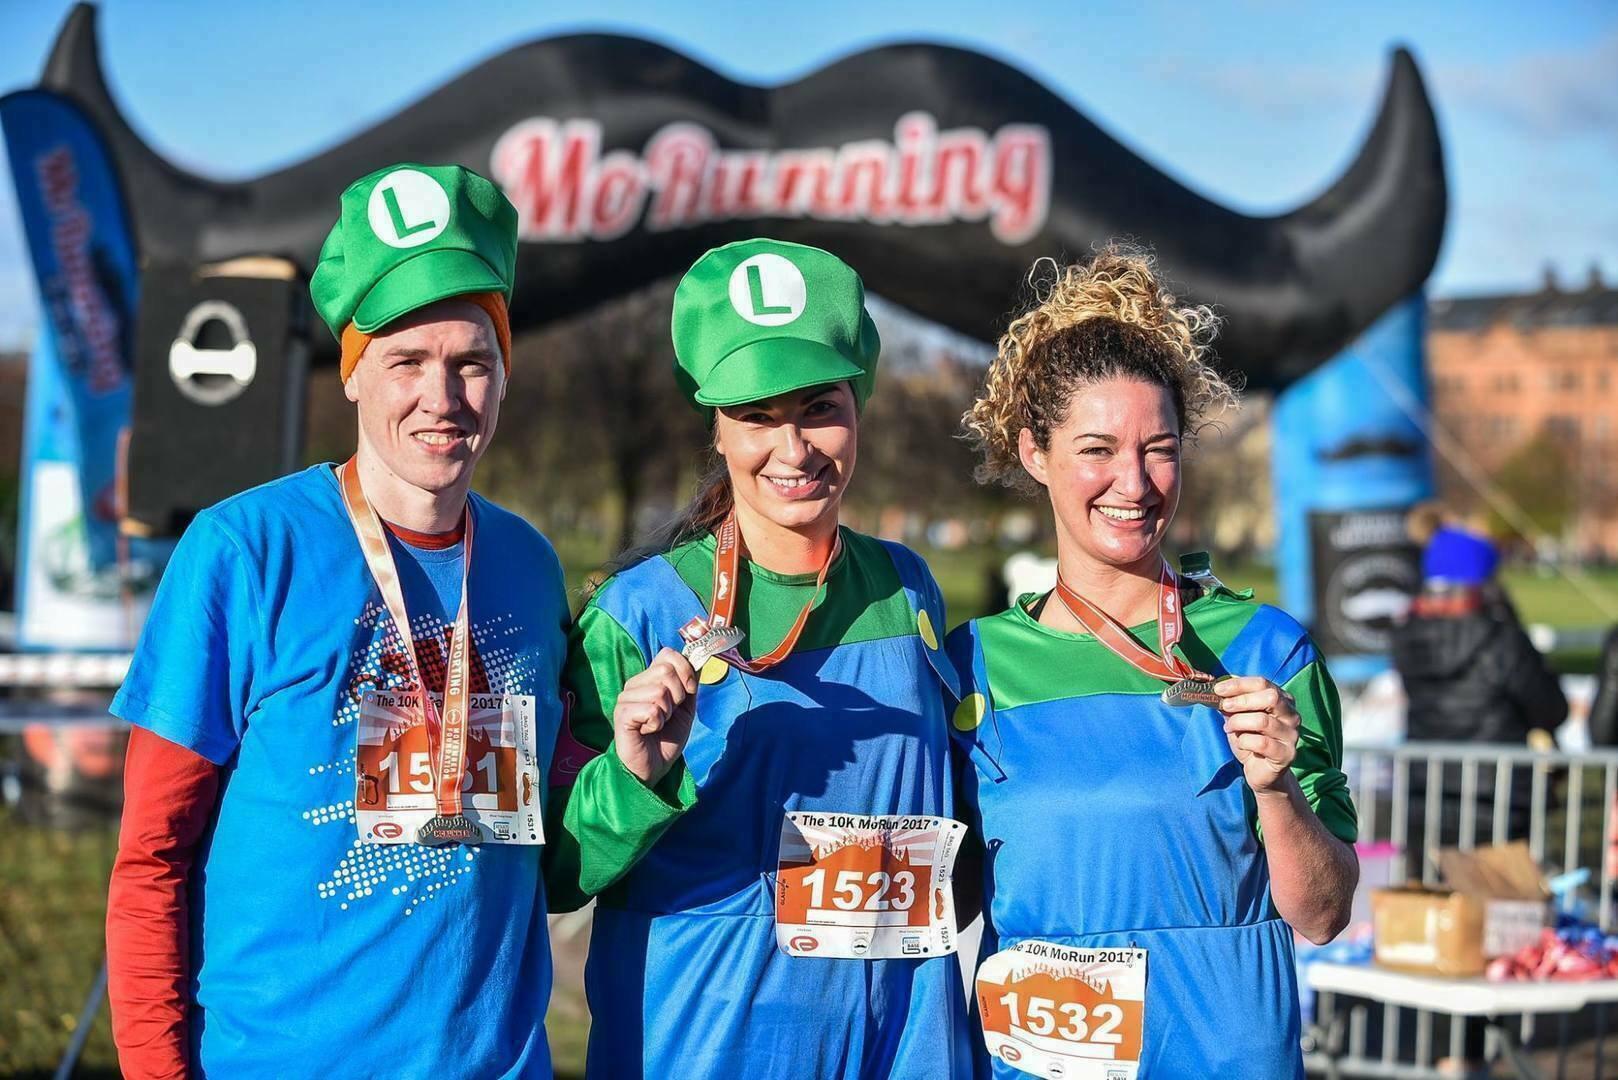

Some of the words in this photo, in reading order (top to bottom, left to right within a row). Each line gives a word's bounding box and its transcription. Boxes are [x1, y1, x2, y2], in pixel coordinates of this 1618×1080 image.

[382, 187, 436, 240] L
[746, 265, 792, 316] L
[449, 619, 463, 695] SUPPORTING
[376, 694, 395, 707] The
[397, 695, 419, 708] 10K
[471, 697, 502, 709] 2017
[802, 815, 825, 827] The
[828, 816, 854, 828] 10K
[858, 818, 899, 830] MoRun
[901, 819, 931, 830] 2017
[802, 868, 916, 911] 1523
[1025, 943, 1048, 957] 10K
[1050, 948, 1095, 963] MoRun
[1099, 952, 1133, 964] 2017
[999, 991, 1123, 1044] 1532
